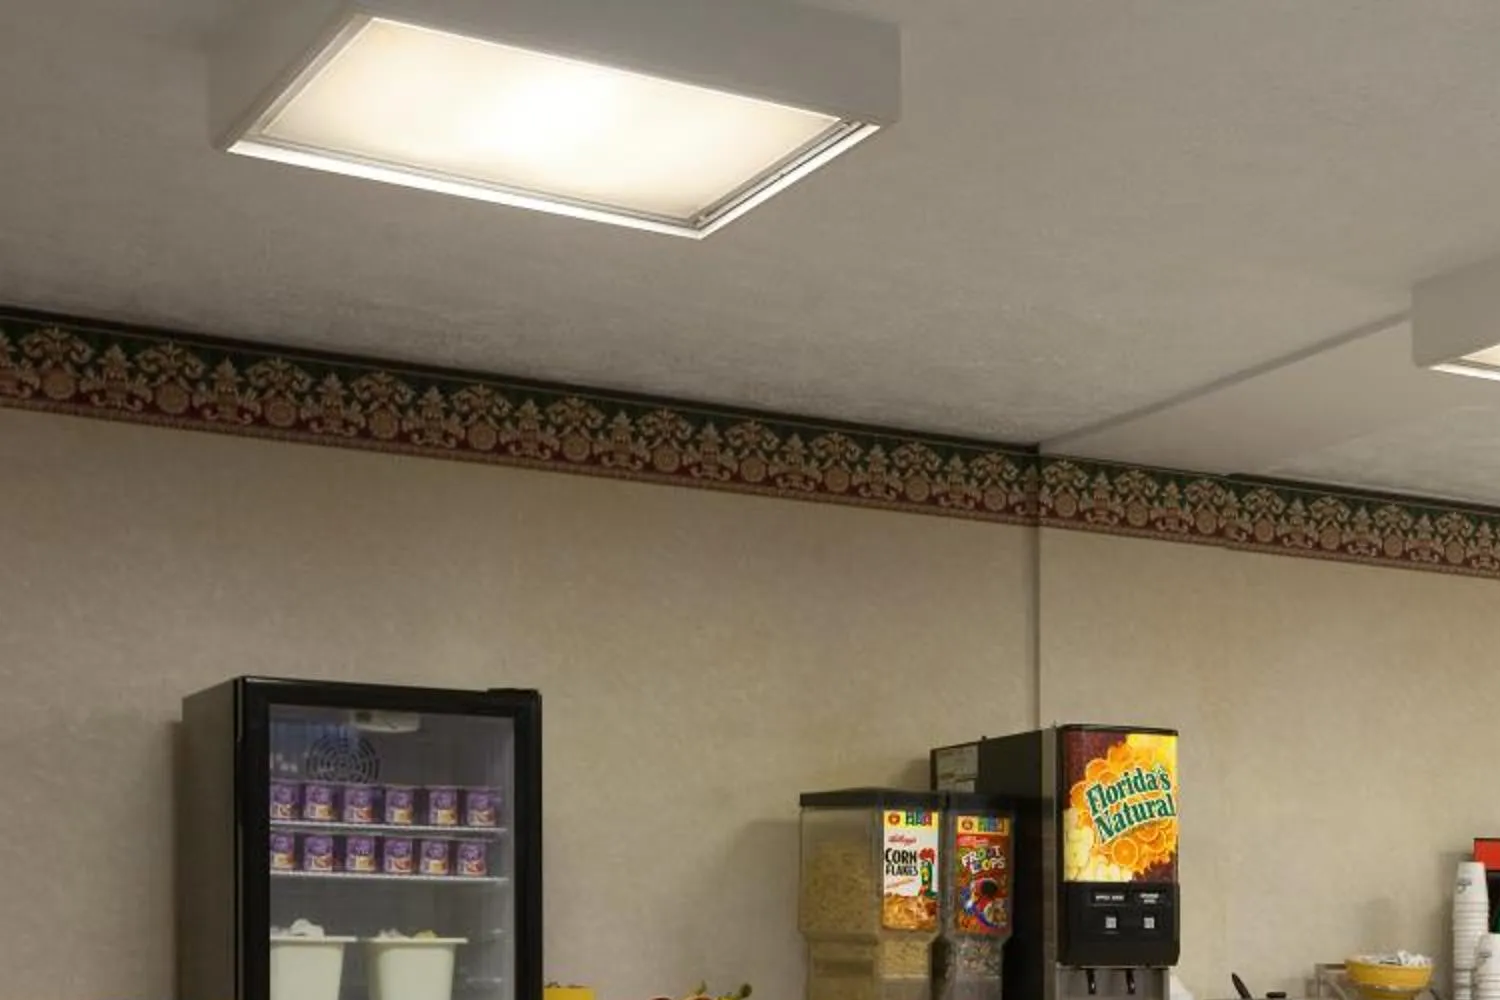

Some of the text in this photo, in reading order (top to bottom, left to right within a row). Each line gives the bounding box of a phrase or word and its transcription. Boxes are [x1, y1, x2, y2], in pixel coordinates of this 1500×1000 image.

[1086, 765, 1171, 817] Florida's
[1093, 792, 1176, 843] Natural
[885, 848, 918, 864] CORN
